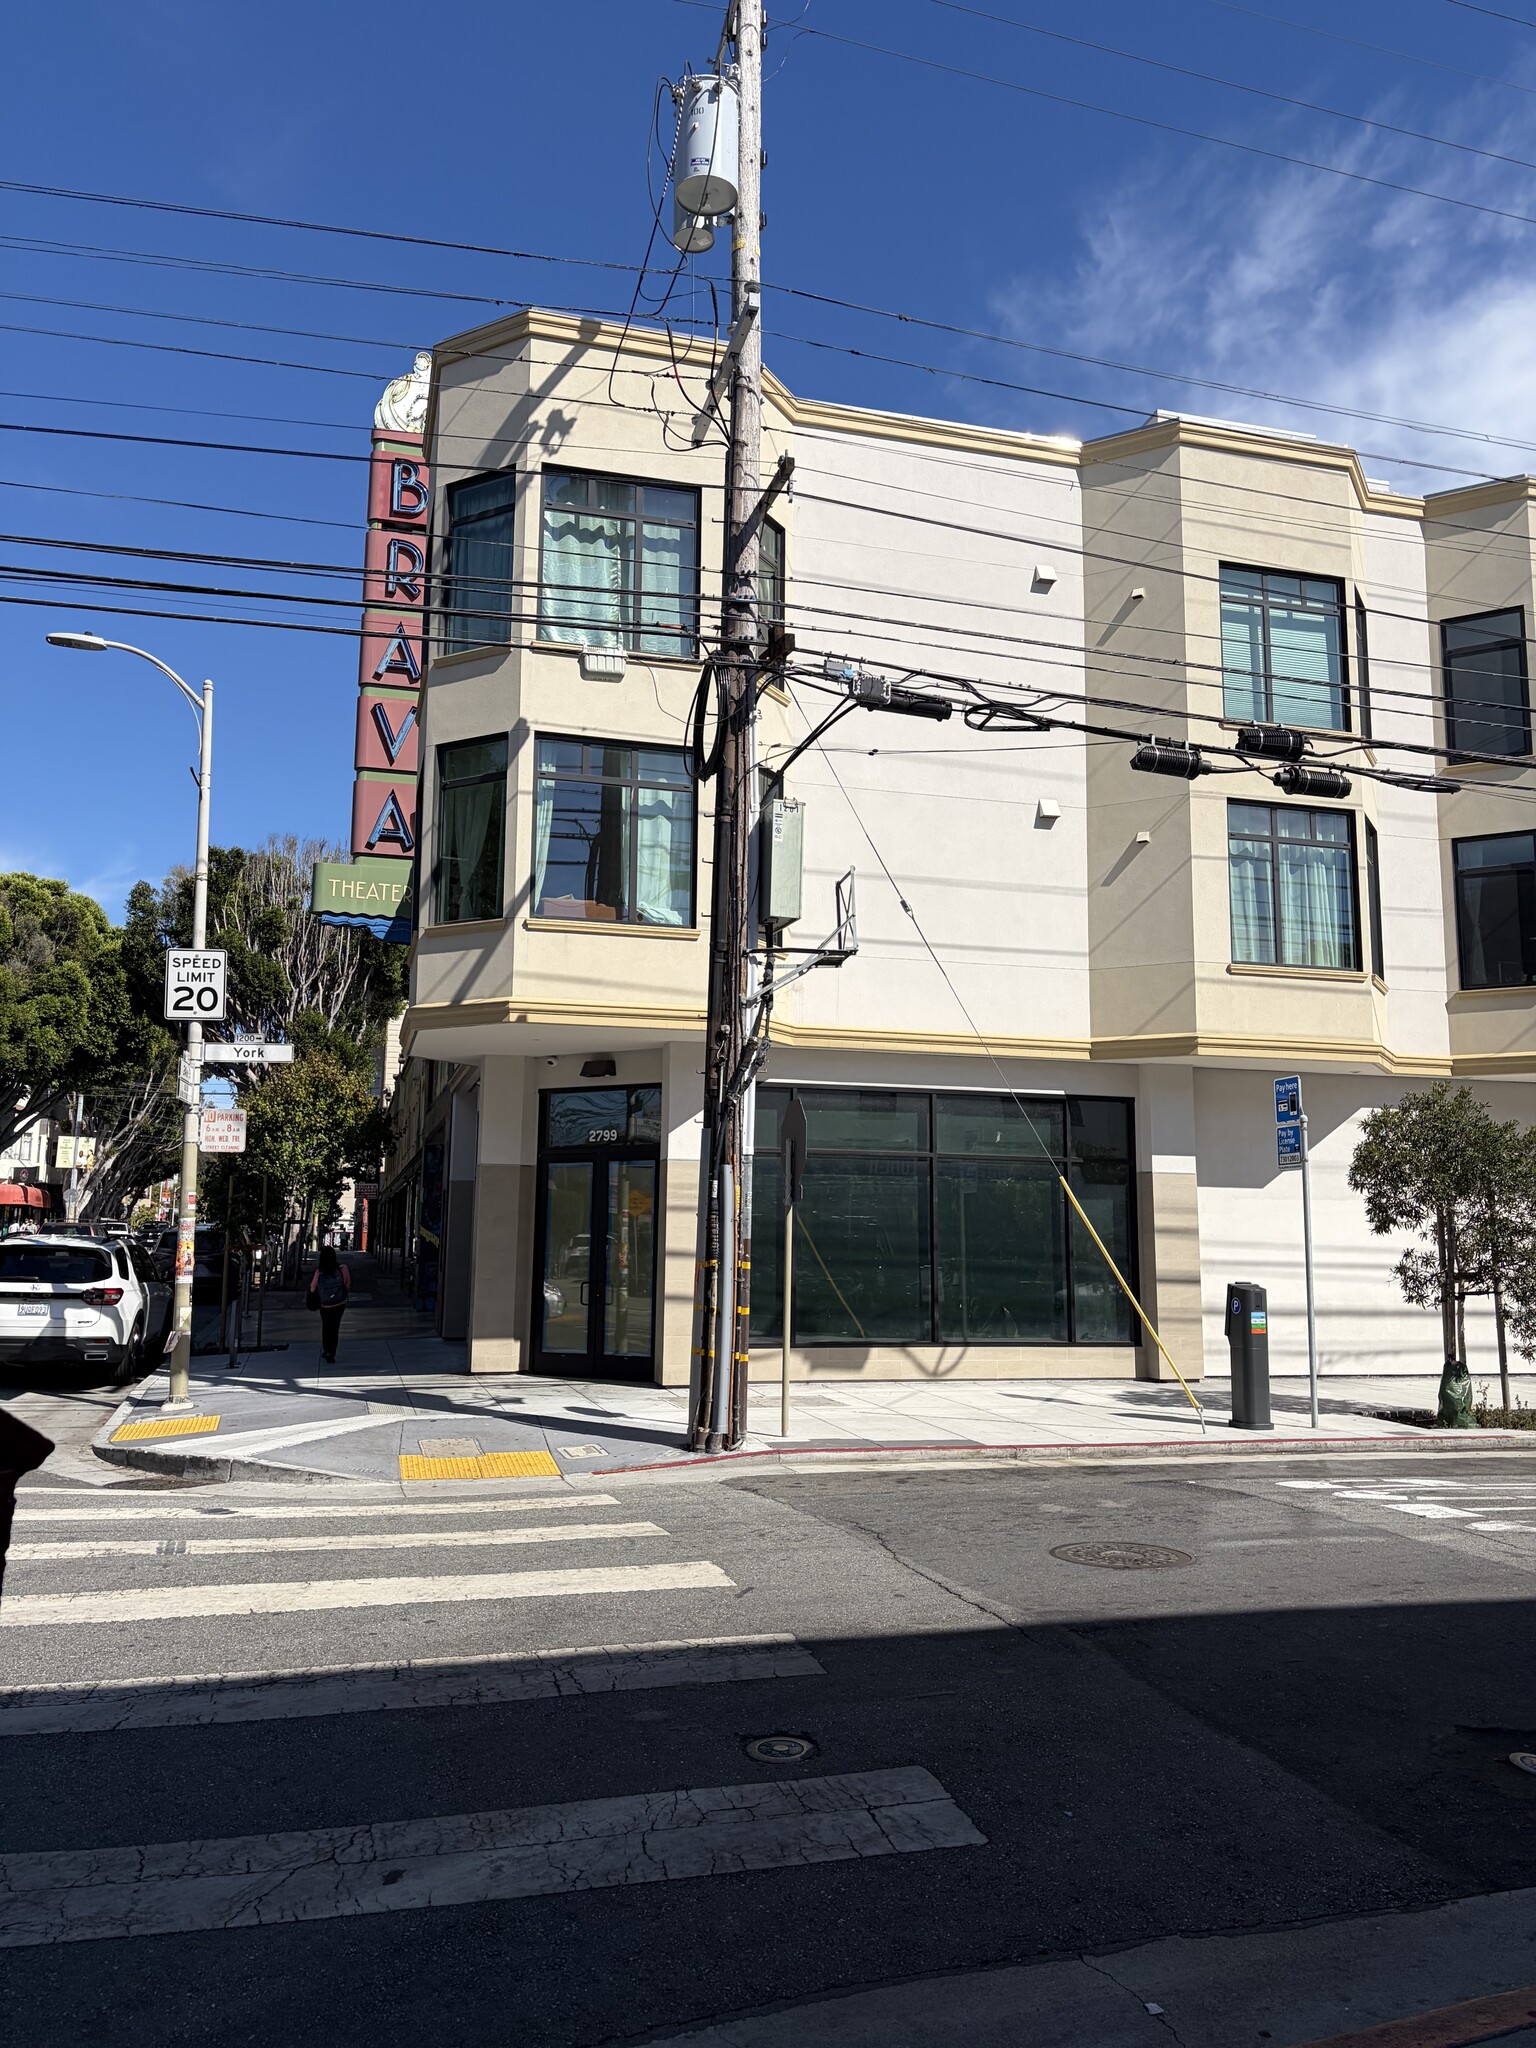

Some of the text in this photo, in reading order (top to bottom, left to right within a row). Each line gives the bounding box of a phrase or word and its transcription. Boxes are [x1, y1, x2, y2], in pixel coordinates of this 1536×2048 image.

[366, 458, 428, 853] BRAVA
[328, 878, 413, 903] THEATER
[172, 957, 221, 969] SPEED
[177, 971, 215, 983] LIMIT
[172, 986, 218, 1012] 20
[236, 1034, 255, 1042] 1200
[233, 1047, 265, 1058] York
[1276, 1082, 1298, 1093] Pay here
[216, 1113, 244, 1122] PARKING
[226, 1124, 232, 1133] 8
[1278, 1128, 1294, 1138] Pay by
[589, 1129, 618, 1142] 2799
[1279, 1145, 1291, 1153] Plate
